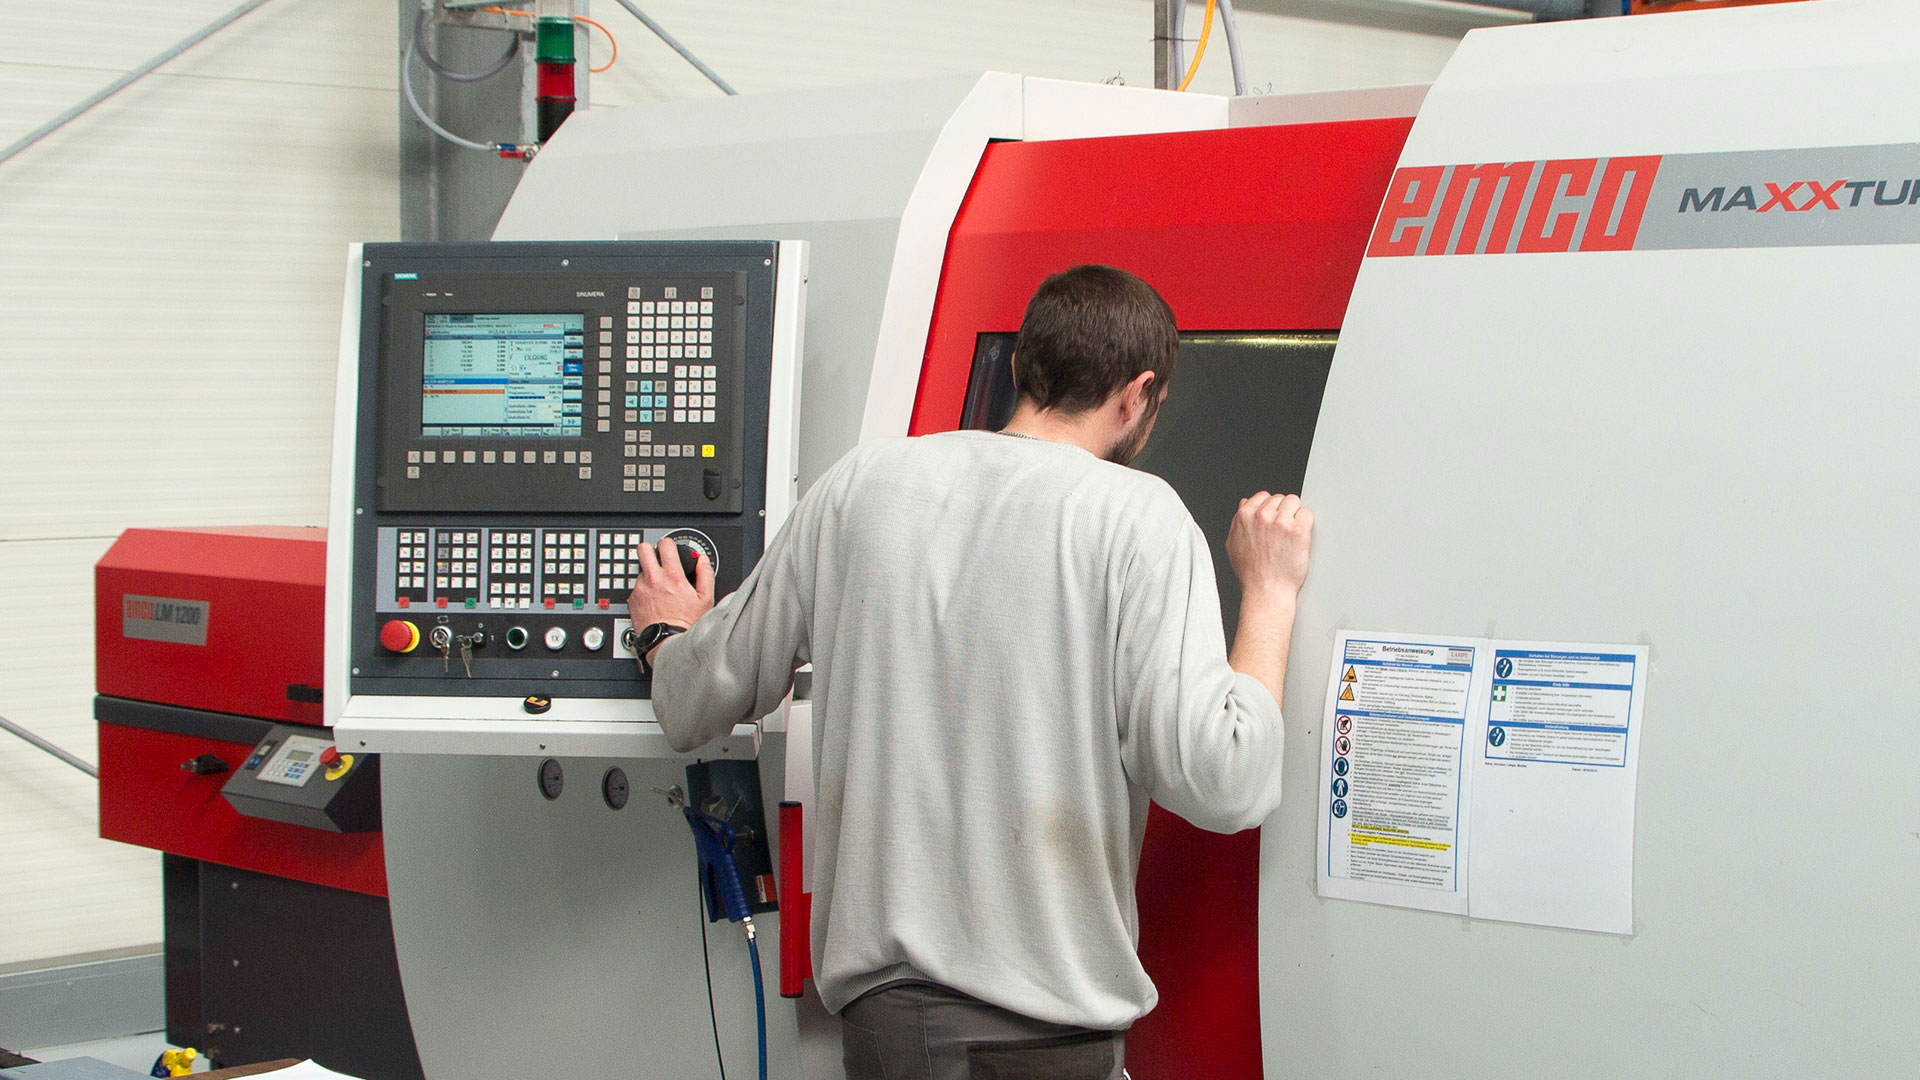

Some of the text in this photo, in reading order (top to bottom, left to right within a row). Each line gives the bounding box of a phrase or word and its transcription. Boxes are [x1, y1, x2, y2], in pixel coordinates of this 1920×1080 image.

[1366, 154, 1663, 257] emco
[156, 603, 173, 621] LM
[174, 606, 201, 625] 1200
[1382, 645, 1435, 657] Betriebsanweisung
